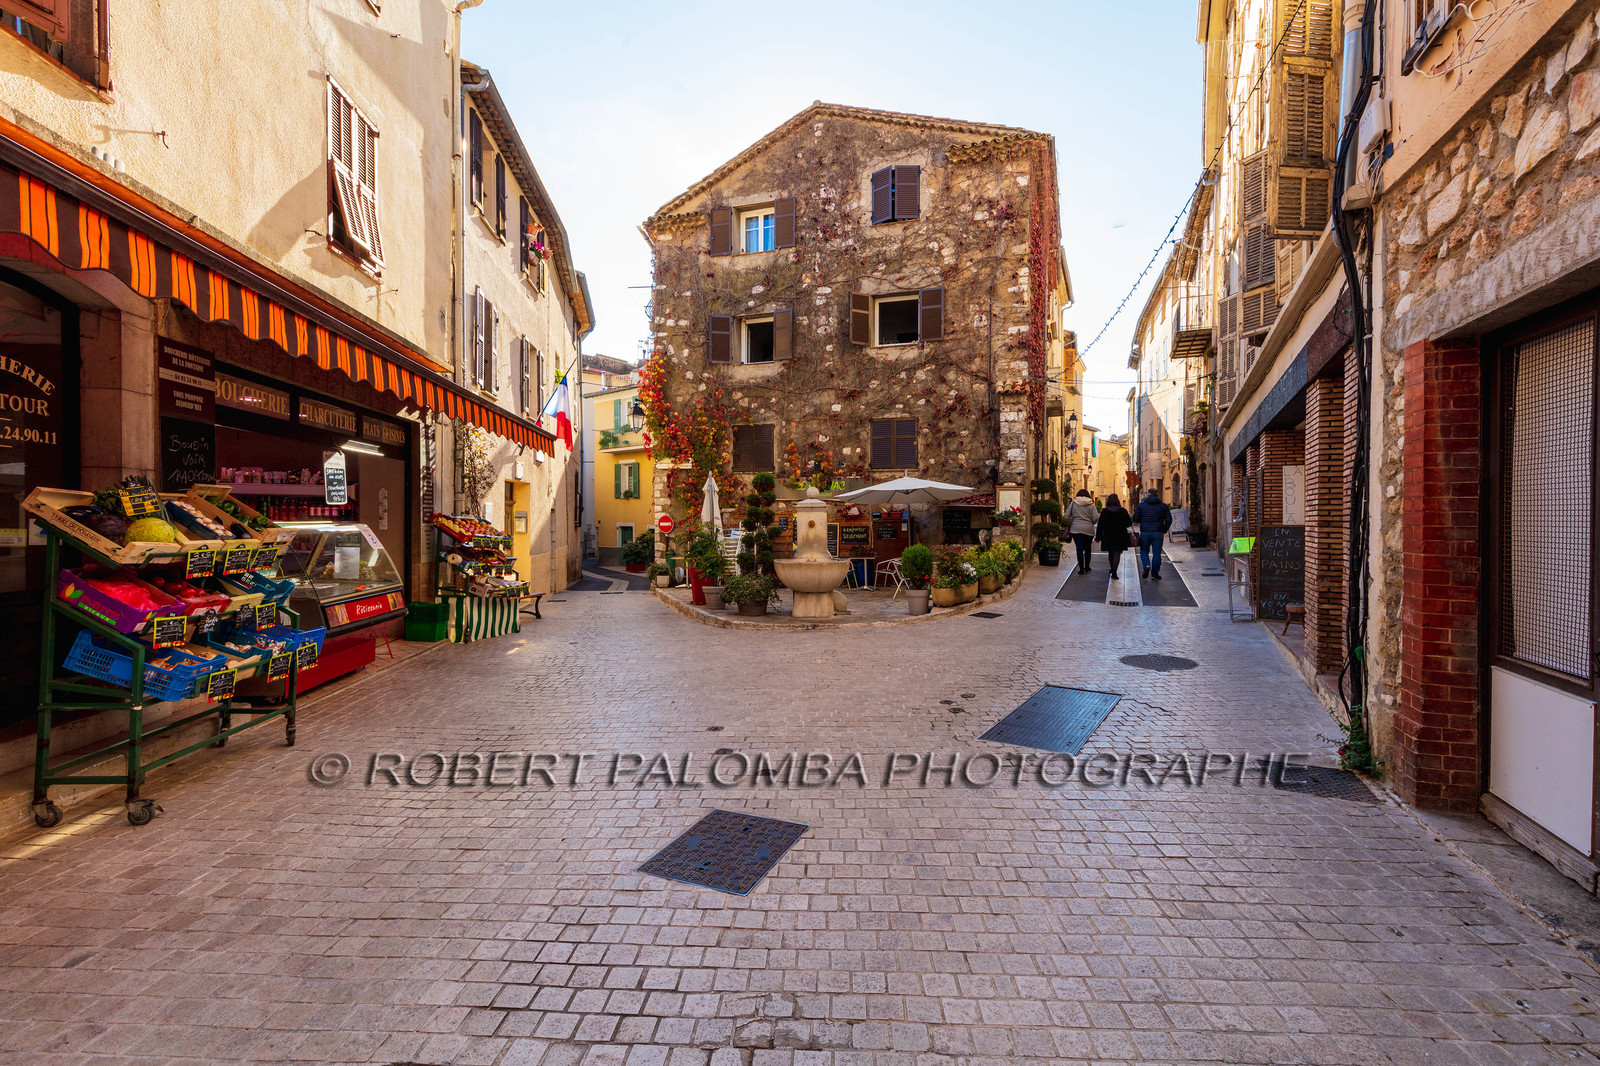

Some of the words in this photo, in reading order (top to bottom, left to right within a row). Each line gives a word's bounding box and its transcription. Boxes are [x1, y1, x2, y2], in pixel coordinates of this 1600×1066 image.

[215, 377, 289, 417] BOUCHERIE
[300, 402, 357, 434] CHARCUTERIE
[363, 422, 380, 438] PLATS
[1283, 466, 1303, 477] LA
[51, 511, 68, 525] TERRE
[76, 526, 101, 543] POMMES
[1274, 528, 1290, 537] EN
[1261, 538, 1303, 549] VENTE
[1272, 549, 1289, 557] ICI
[1261, 559, 1302, 570] PAINS
[1273, 593, 1287, 601] EN
[80, 594, 121, 621] ENDIVES
